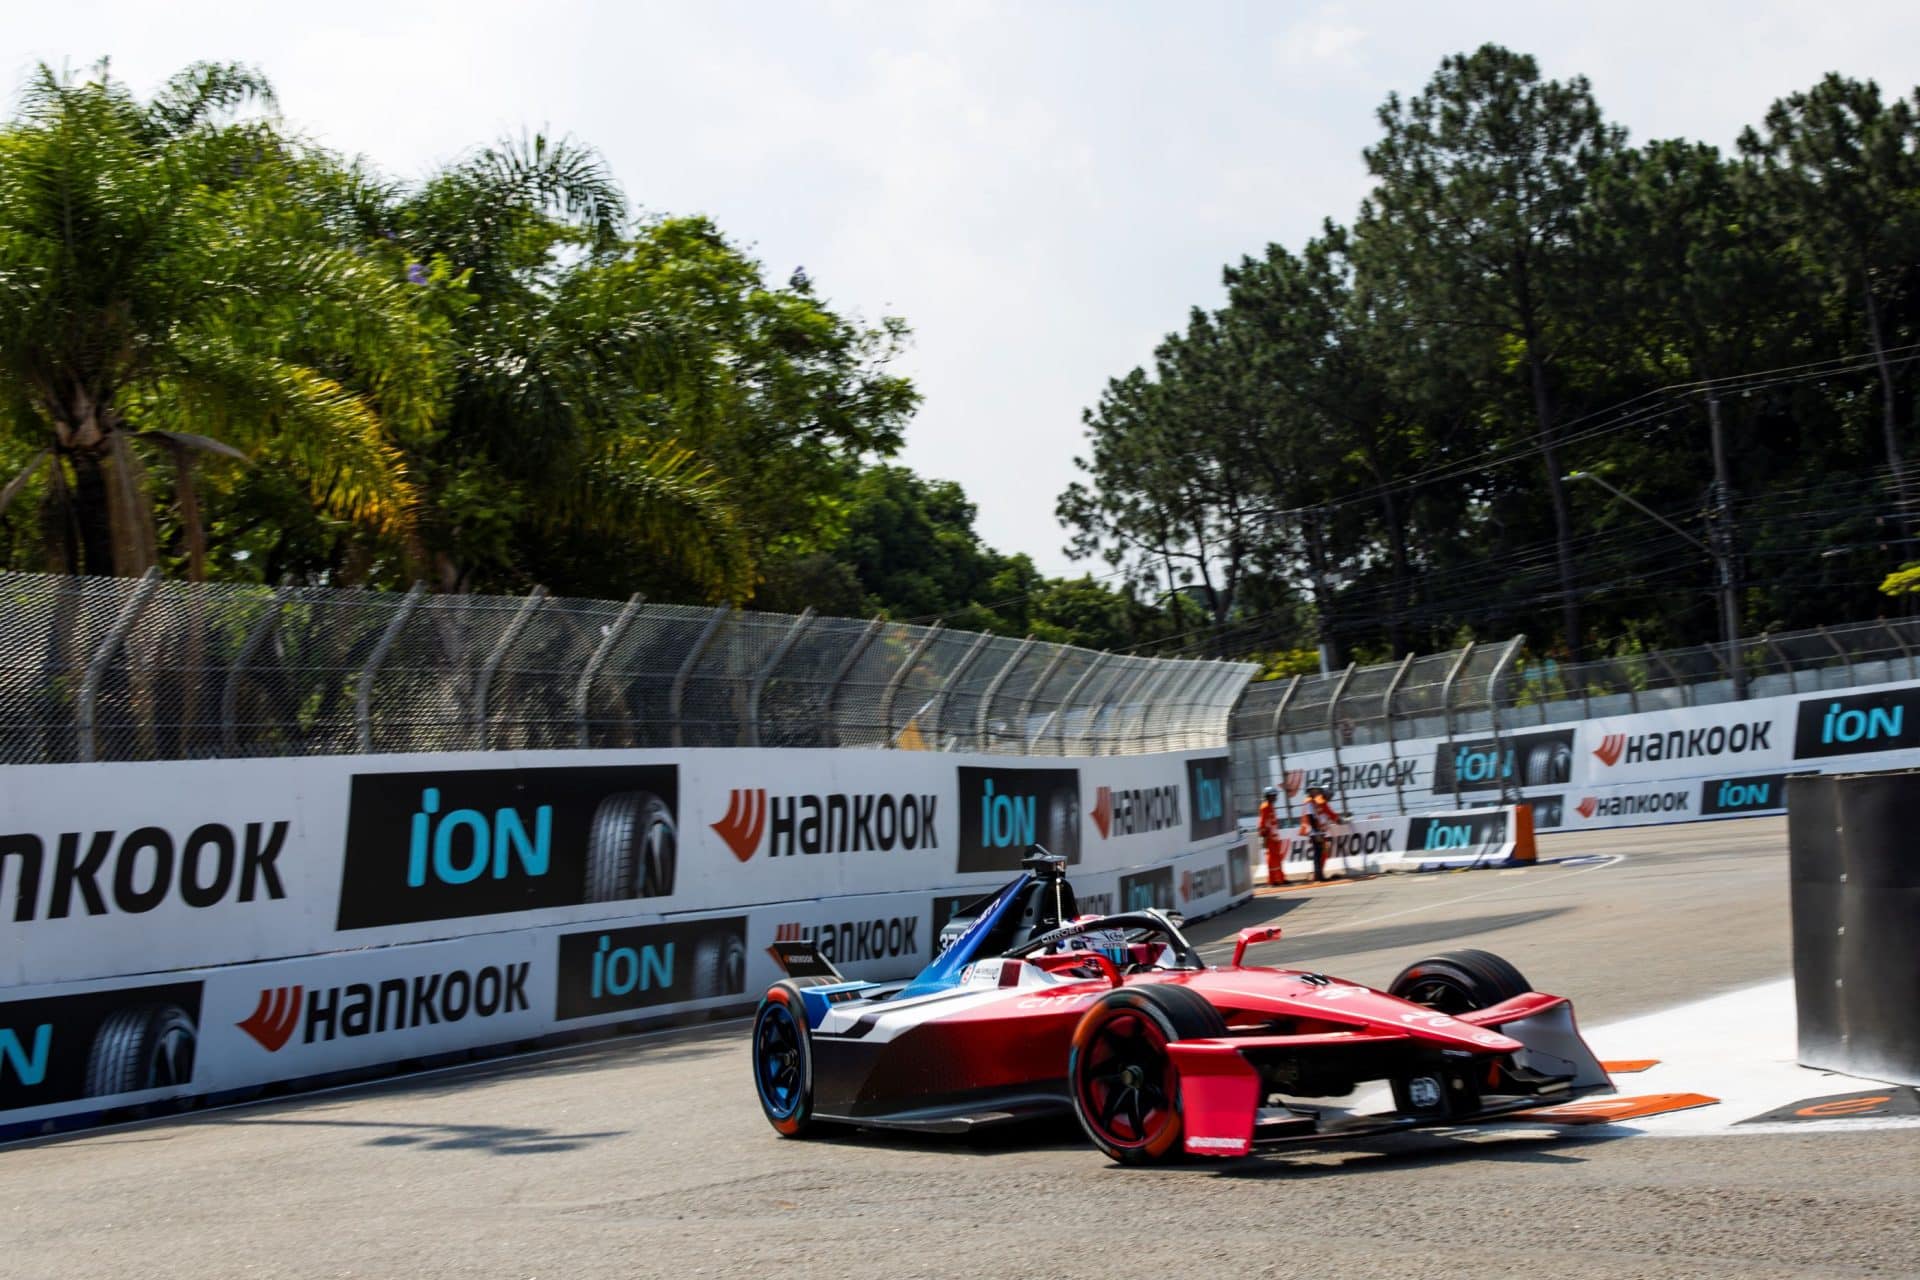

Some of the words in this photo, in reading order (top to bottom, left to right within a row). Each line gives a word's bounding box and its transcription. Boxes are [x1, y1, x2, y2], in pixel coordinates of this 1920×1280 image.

[1821, 703, 1905, 745] iON
[407, 787, 554, 888] iON
[981, 778, 1037, 848] iON
[591, 935, 676, 998] iON
